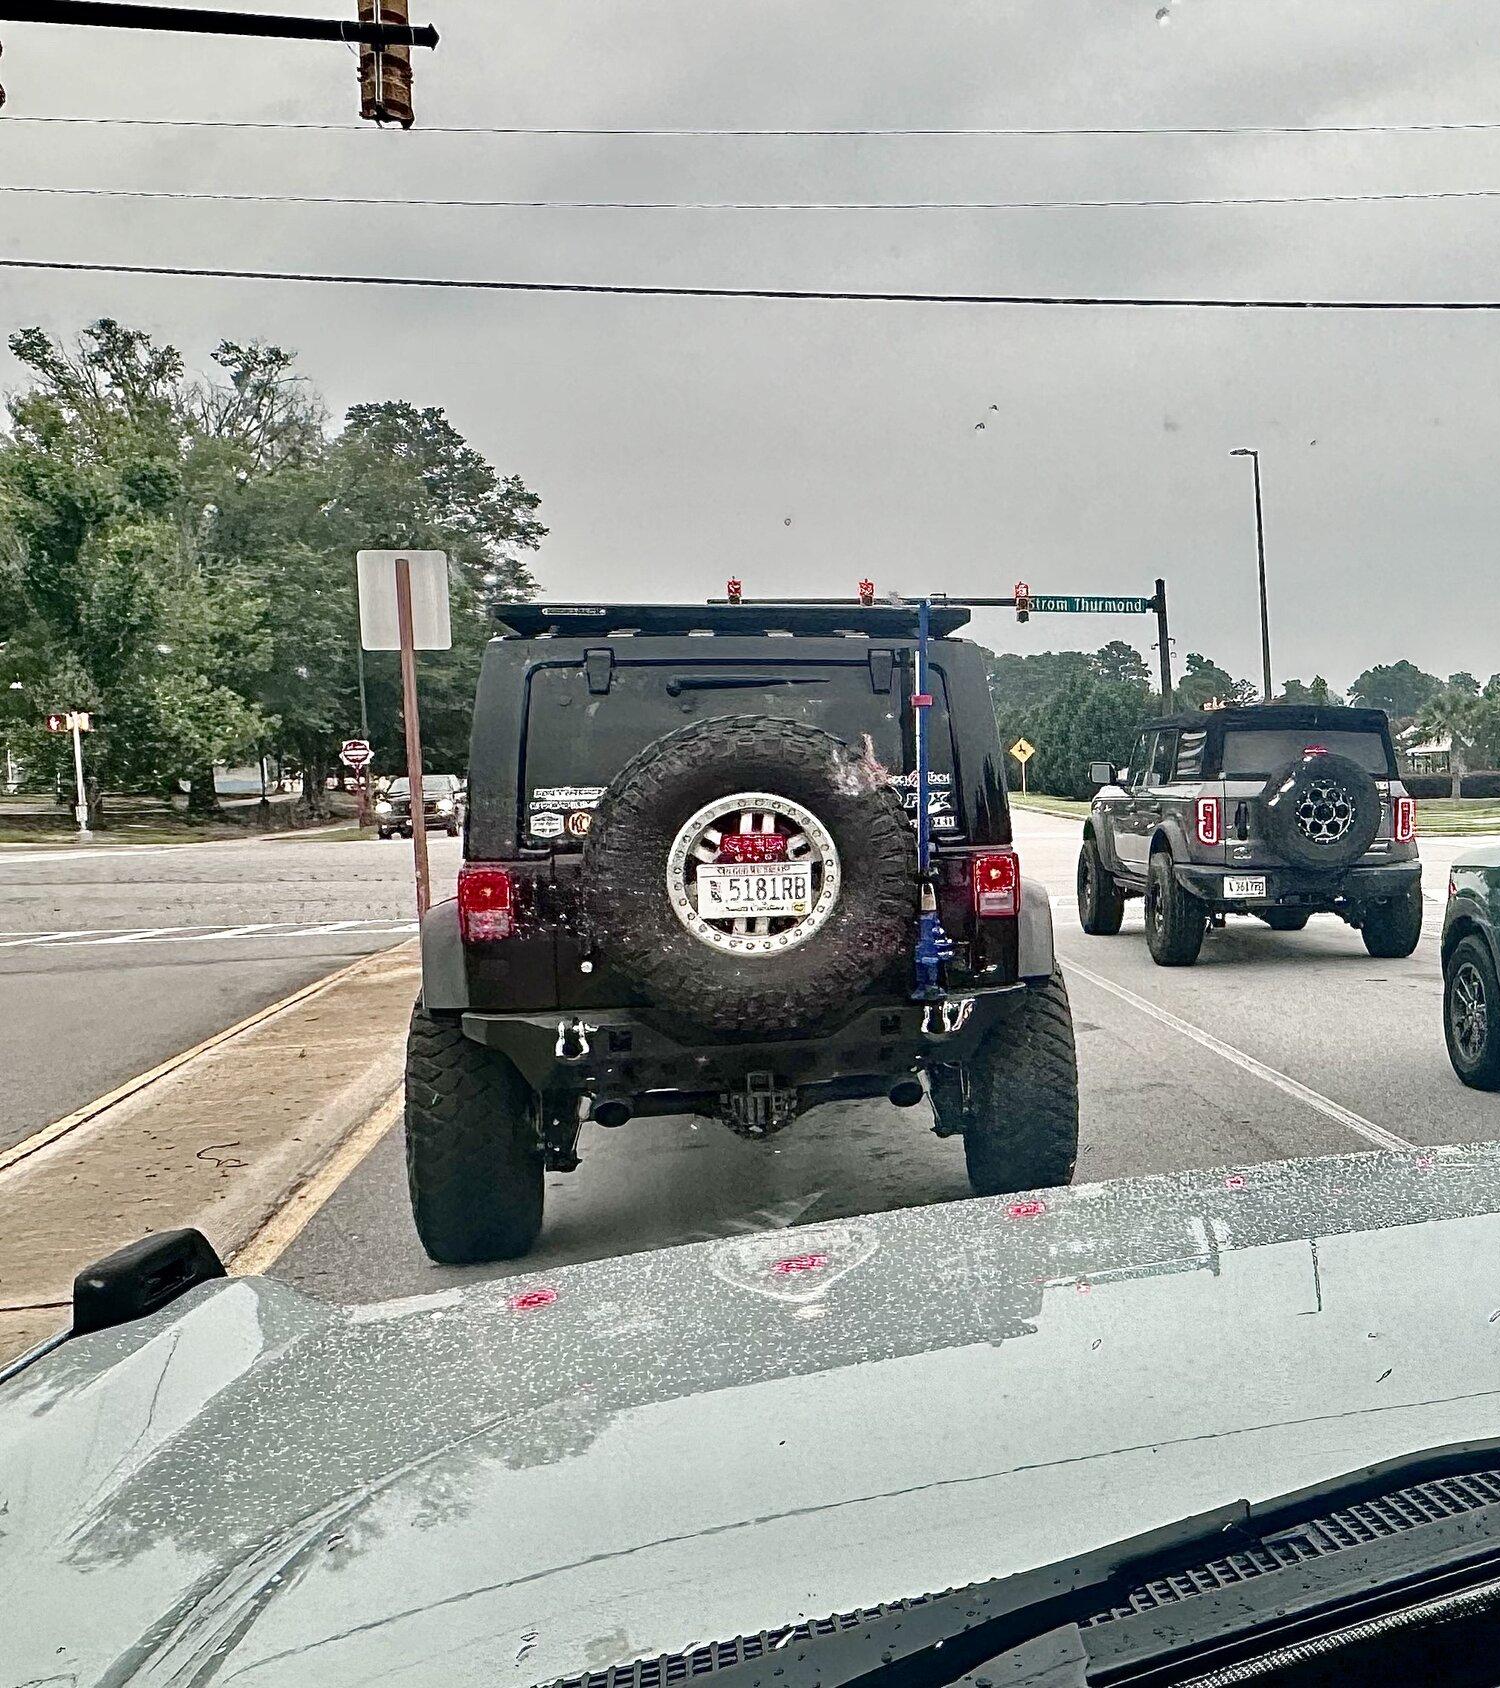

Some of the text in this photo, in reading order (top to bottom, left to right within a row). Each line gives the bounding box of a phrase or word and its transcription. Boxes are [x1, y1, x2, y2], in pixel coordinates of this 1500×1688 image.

[1029, 598, 1142, 612] Strom Thurmond
[729, 877, 806, 901] 5181RB
